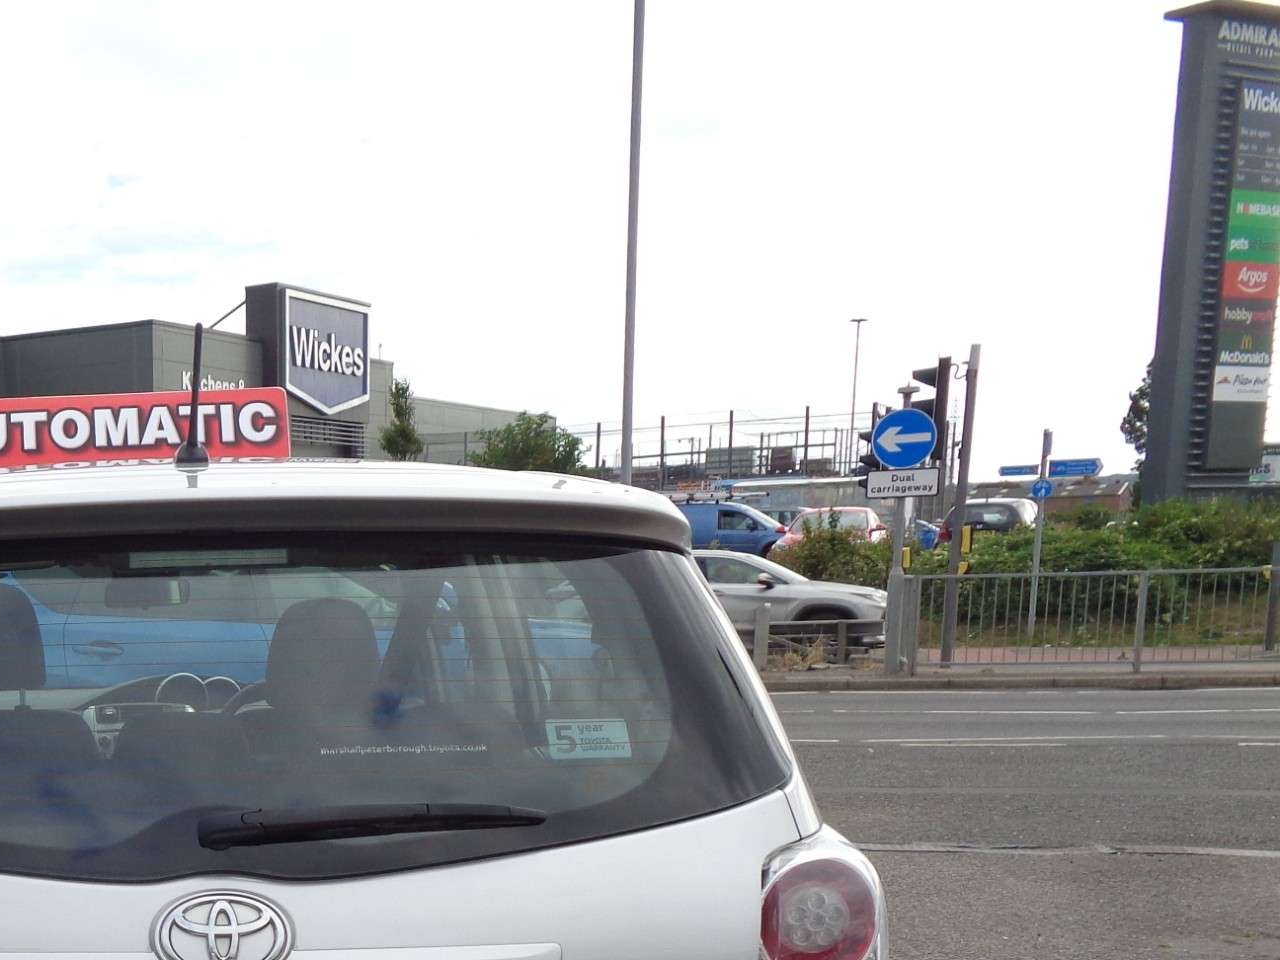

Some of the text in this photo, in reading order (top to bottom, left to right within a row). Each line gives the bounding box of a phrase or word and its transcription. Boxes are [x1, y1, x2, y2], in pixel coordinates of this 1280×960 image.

[1218, 20, 1280, 47] ADMIRA
[1244, 87, 1280, 113] Wick
[1238, 266, 1268, 286] Argos
[292, 325, 364, 377] Wickes
[182, 370, 235, 391] Kchens
[891, 473, 915, 483] Dual
[870, 484, 934, 494] carriageway
[554, 724, 577, 753] 5
[577, 724, 605, 735] year
